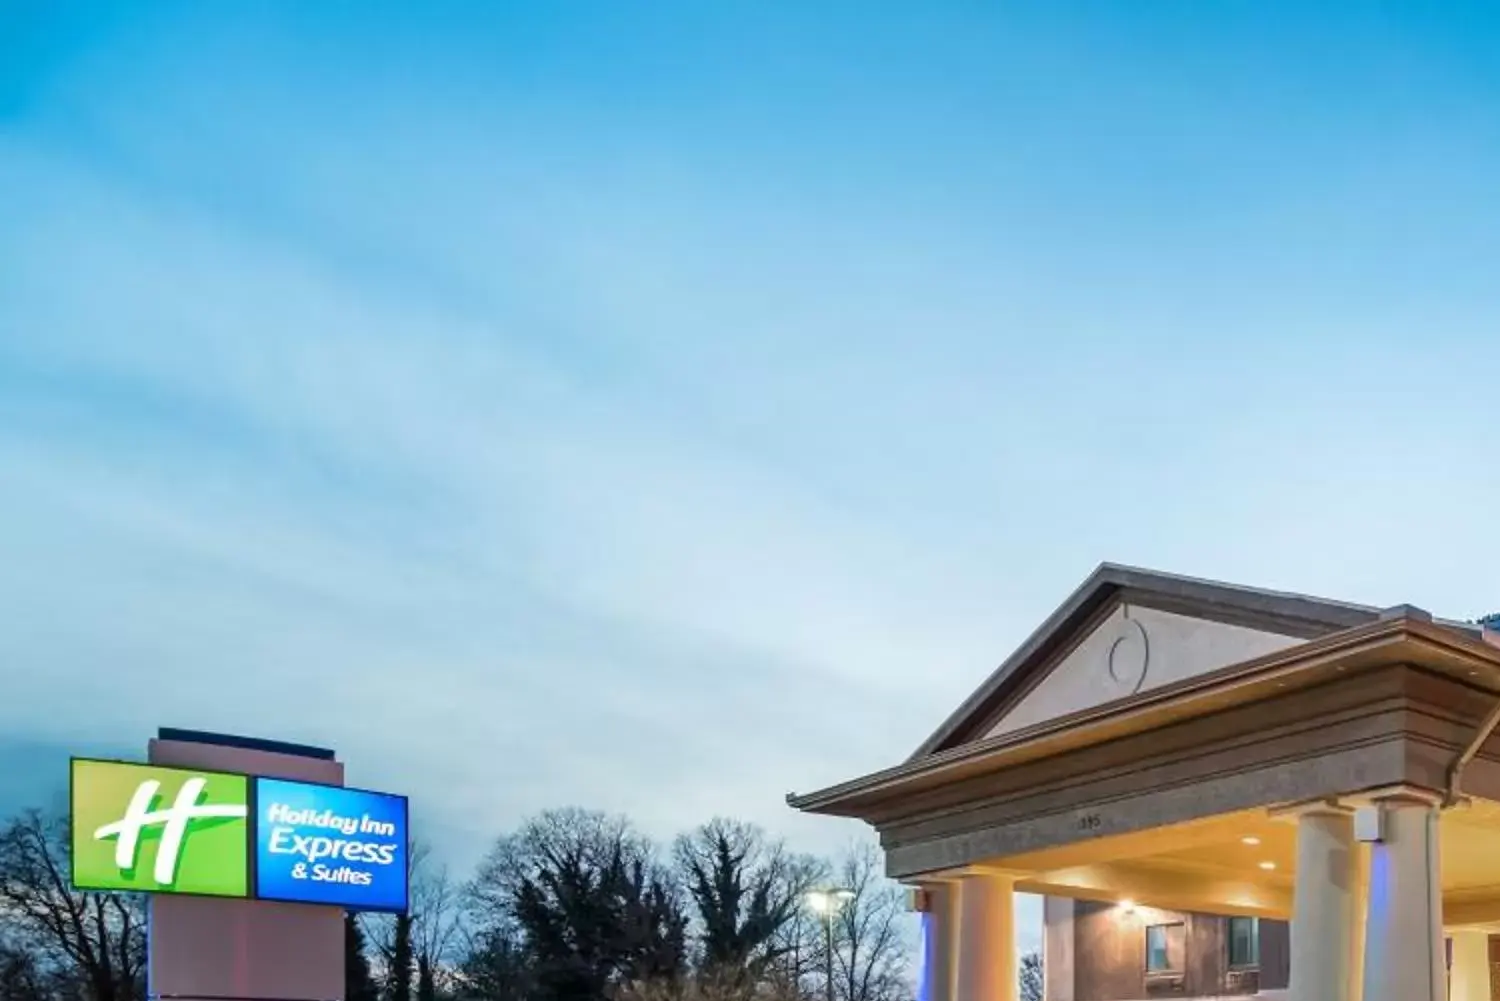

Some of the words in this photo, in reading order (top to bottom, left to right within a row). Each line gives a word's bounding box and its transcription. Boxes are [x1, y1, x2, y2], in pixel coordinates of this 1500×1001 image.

[267, 802, 359, 836] Holiday
[360, 811, 395, 837] Inn
[268, 826, 398, 865] Express
[291, 863, 308, 881] &
[312, 863, 372, 885] Suites
